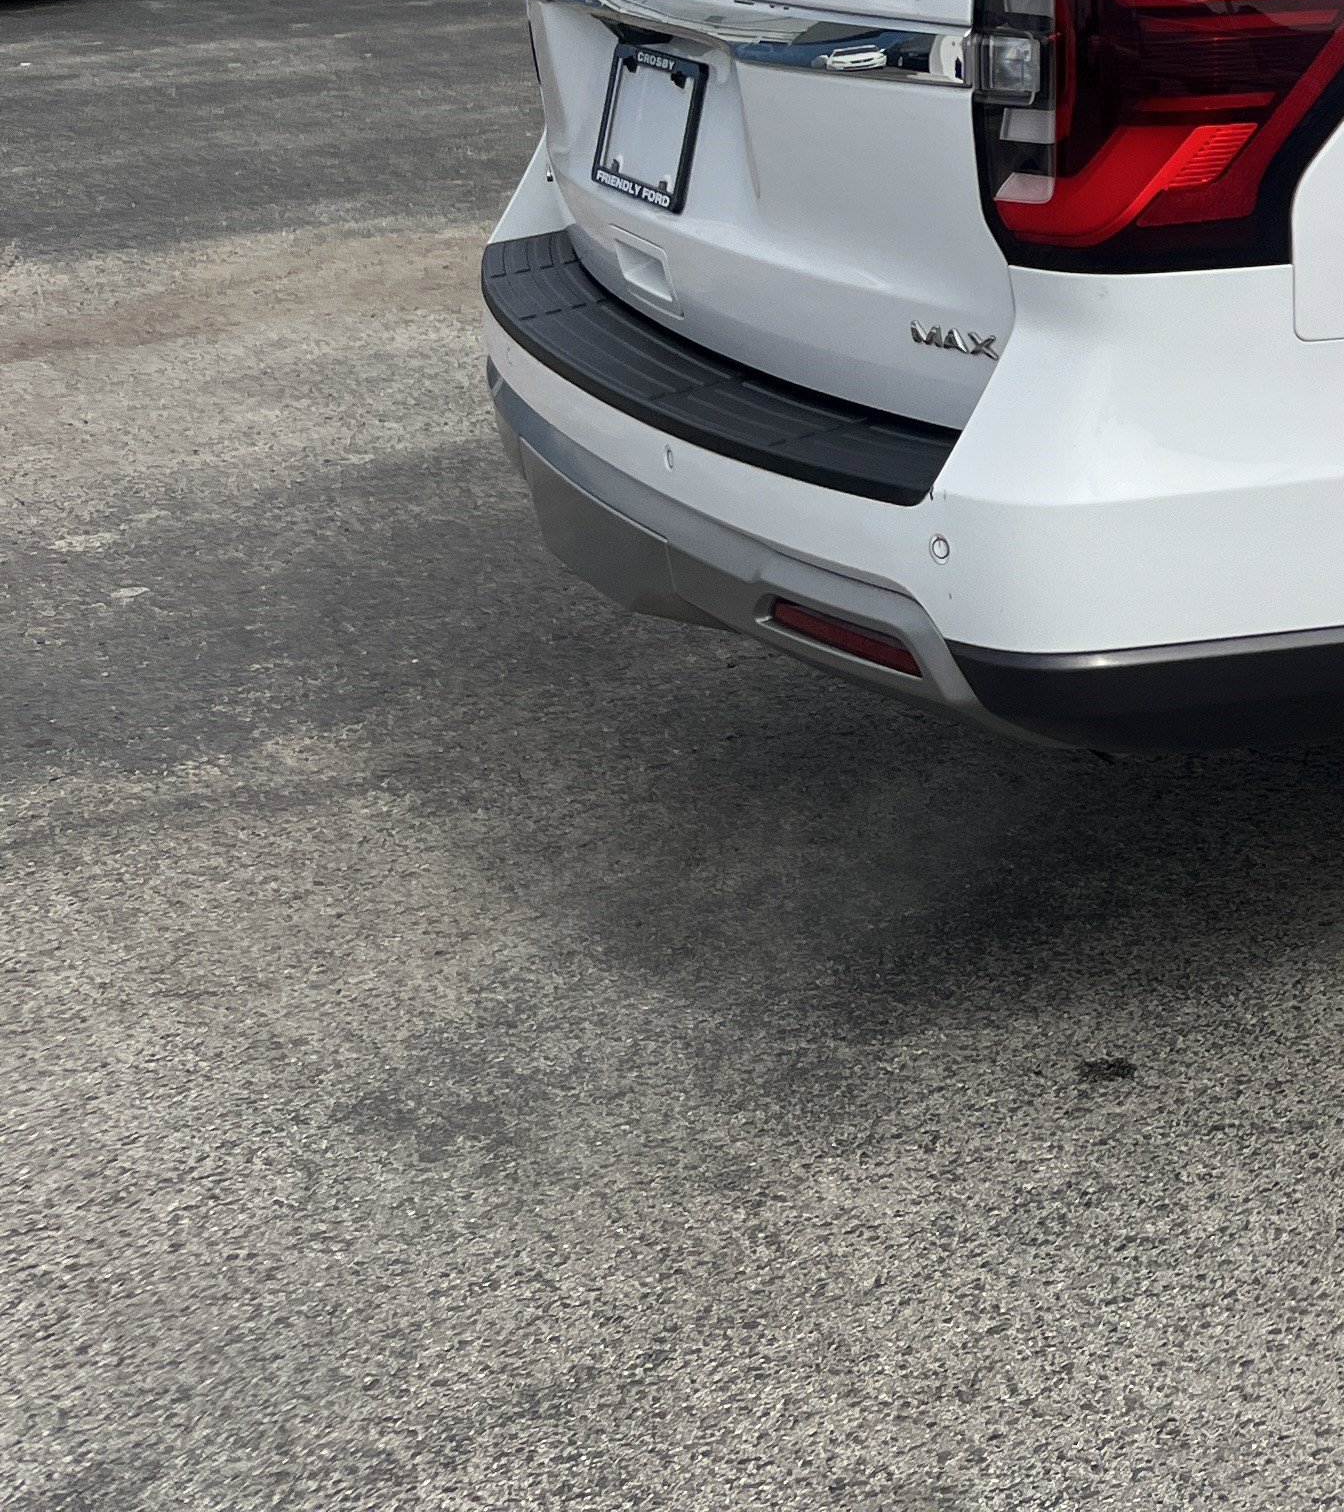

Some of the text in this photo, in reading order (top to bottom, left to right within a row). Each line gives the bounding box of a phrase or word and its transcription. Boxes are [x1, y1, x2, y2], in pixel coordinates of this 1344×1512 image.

[636, 51, 676, 71] CROSBY
[596, 169, 671, 208] FRIENDLY FORD
[910, 319, 999, 361] MAX
